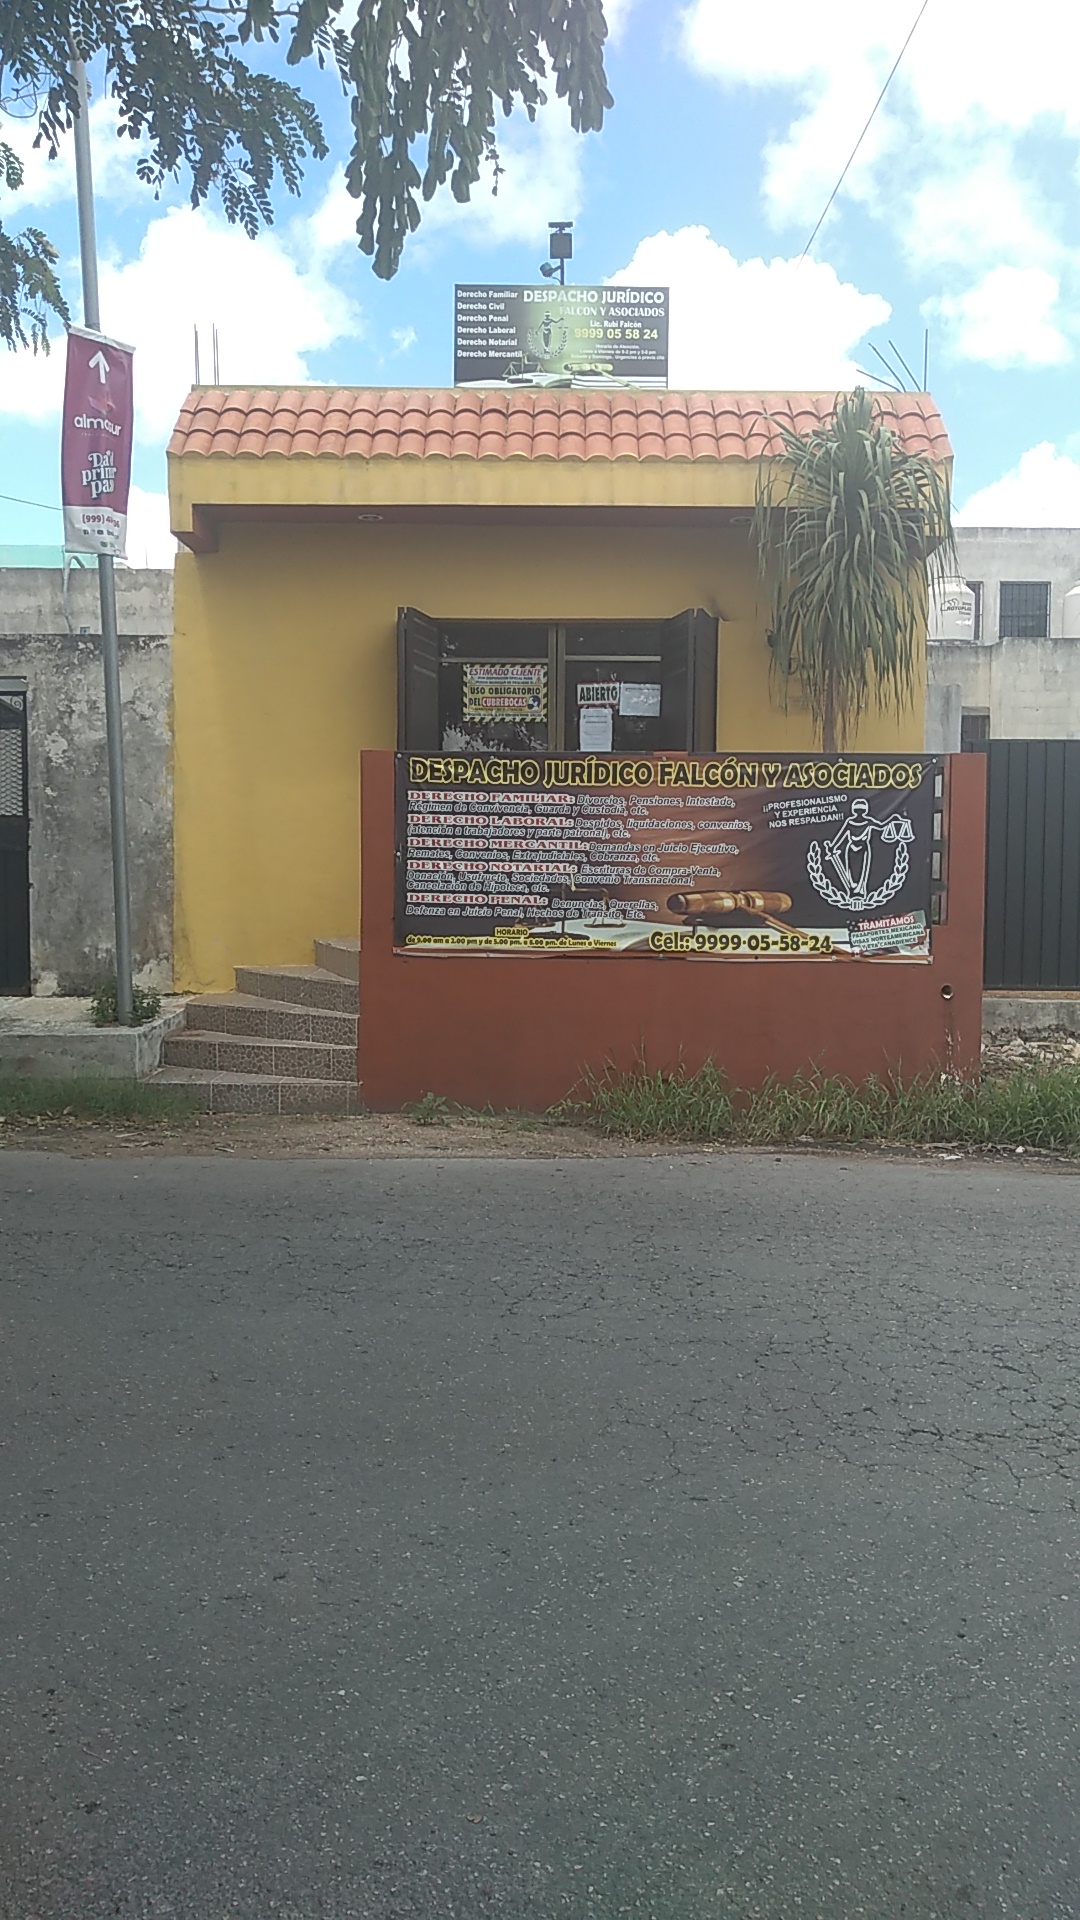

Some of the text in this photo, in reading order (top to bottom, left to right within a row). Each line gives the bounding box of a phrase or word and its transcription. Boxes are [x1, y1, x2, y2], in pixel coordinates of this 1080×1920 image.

[523, 288, 664, 304] DESPACHO JURÍDICO
[489, 302, 505, 310] Civil
[608, 307, 665, 317] ASOCIADOS
[590, 319, 602, 327] Lic.
[489, 326, 516, 334] Laboral
[574, 328, 658, 339] 9999 05 58 24
[489, 338, 518, 346] Notarial
[82, 514, 105, 524] (999)
[469, 668, 541, 676] ESTIMADO CLIENTE
[470, 687, 541, 695] USO OBLIGATORIO
[579, 686, 618, 702] ABIERTO
[469, 697, 527, 707] DEL CUBREBOCAS
[409, 756, 922, 789] DESPACHO JURÍDICO FALCÓN Y ASOCIADOS
[407, 790, 736, 808] DERECHO FAMILIAR: Divorcios, Pensiones, Intestado,
[408, 801, 453, 813] Régimen
[453, 802, 468, 812] de
[469, 802, 532, 814] Convivencia,
[535, 804, 571, 814] Guarda
[582, 804, 628, 816] Custodia,
[630, 805, 649, 815] etc.
[782, 804, 838, 818] EXPERIENCIA
[407, 814, 752, 831] DERECHO LABORAL: Despidos, liquidaciones, convenios,
[769, 820, 787, 829] NOS
[407, 824, 453, 836] (atención
[463, 825, 525, 838] trabajadores
[526, 829, 535, 838] y
[535, 828, 562, 838] parte
[563, 828, 610, 840] patronal),
[612, 829, 631, 838] etc.
[407, 837, 489, 849] DERECHO
[488, 838, 588, 850] MERCANTIL:
[588, 842, 641, 852] Demandas
[657, 843, 688, 853] Juicio
[690, 843, 739, 855] Ejecutivo,
[407, 848, 660, 863] Remates, Convenios, Extrajudiciales, Cobranza, etc.
[407, 860, 721, 878] DERECHO NOTARIAL: Escrituras de Compra-Venta,
[406, 870, 695, 887] Donación, Usufructo, Sociedades, Convenio Transnacional,
[407, 880, 550, 893] Cancelación de Hipoteca, etc.
[406, 893, 659, 911] DERECHO PENAL: Denuncias, Querellas,
[406, 904, 446, 915] Defenza
[447, 907, 460, 916] en
[461, 906, 492, 917] Juicio
[494, 907, 525, 918] Penal,
[526, 907, 564, 918] Hechos
[565, 908, 579, 918] de
[626, 909, 646, 919] Etc.
[858, 915, 915, 931] TRAMITAMOS
[495, 928, 529, 937] HORARIO
[852, 928, 890, 938] PASAPORTES
[871, 930, 925, 942] NORTEAMERICANA
